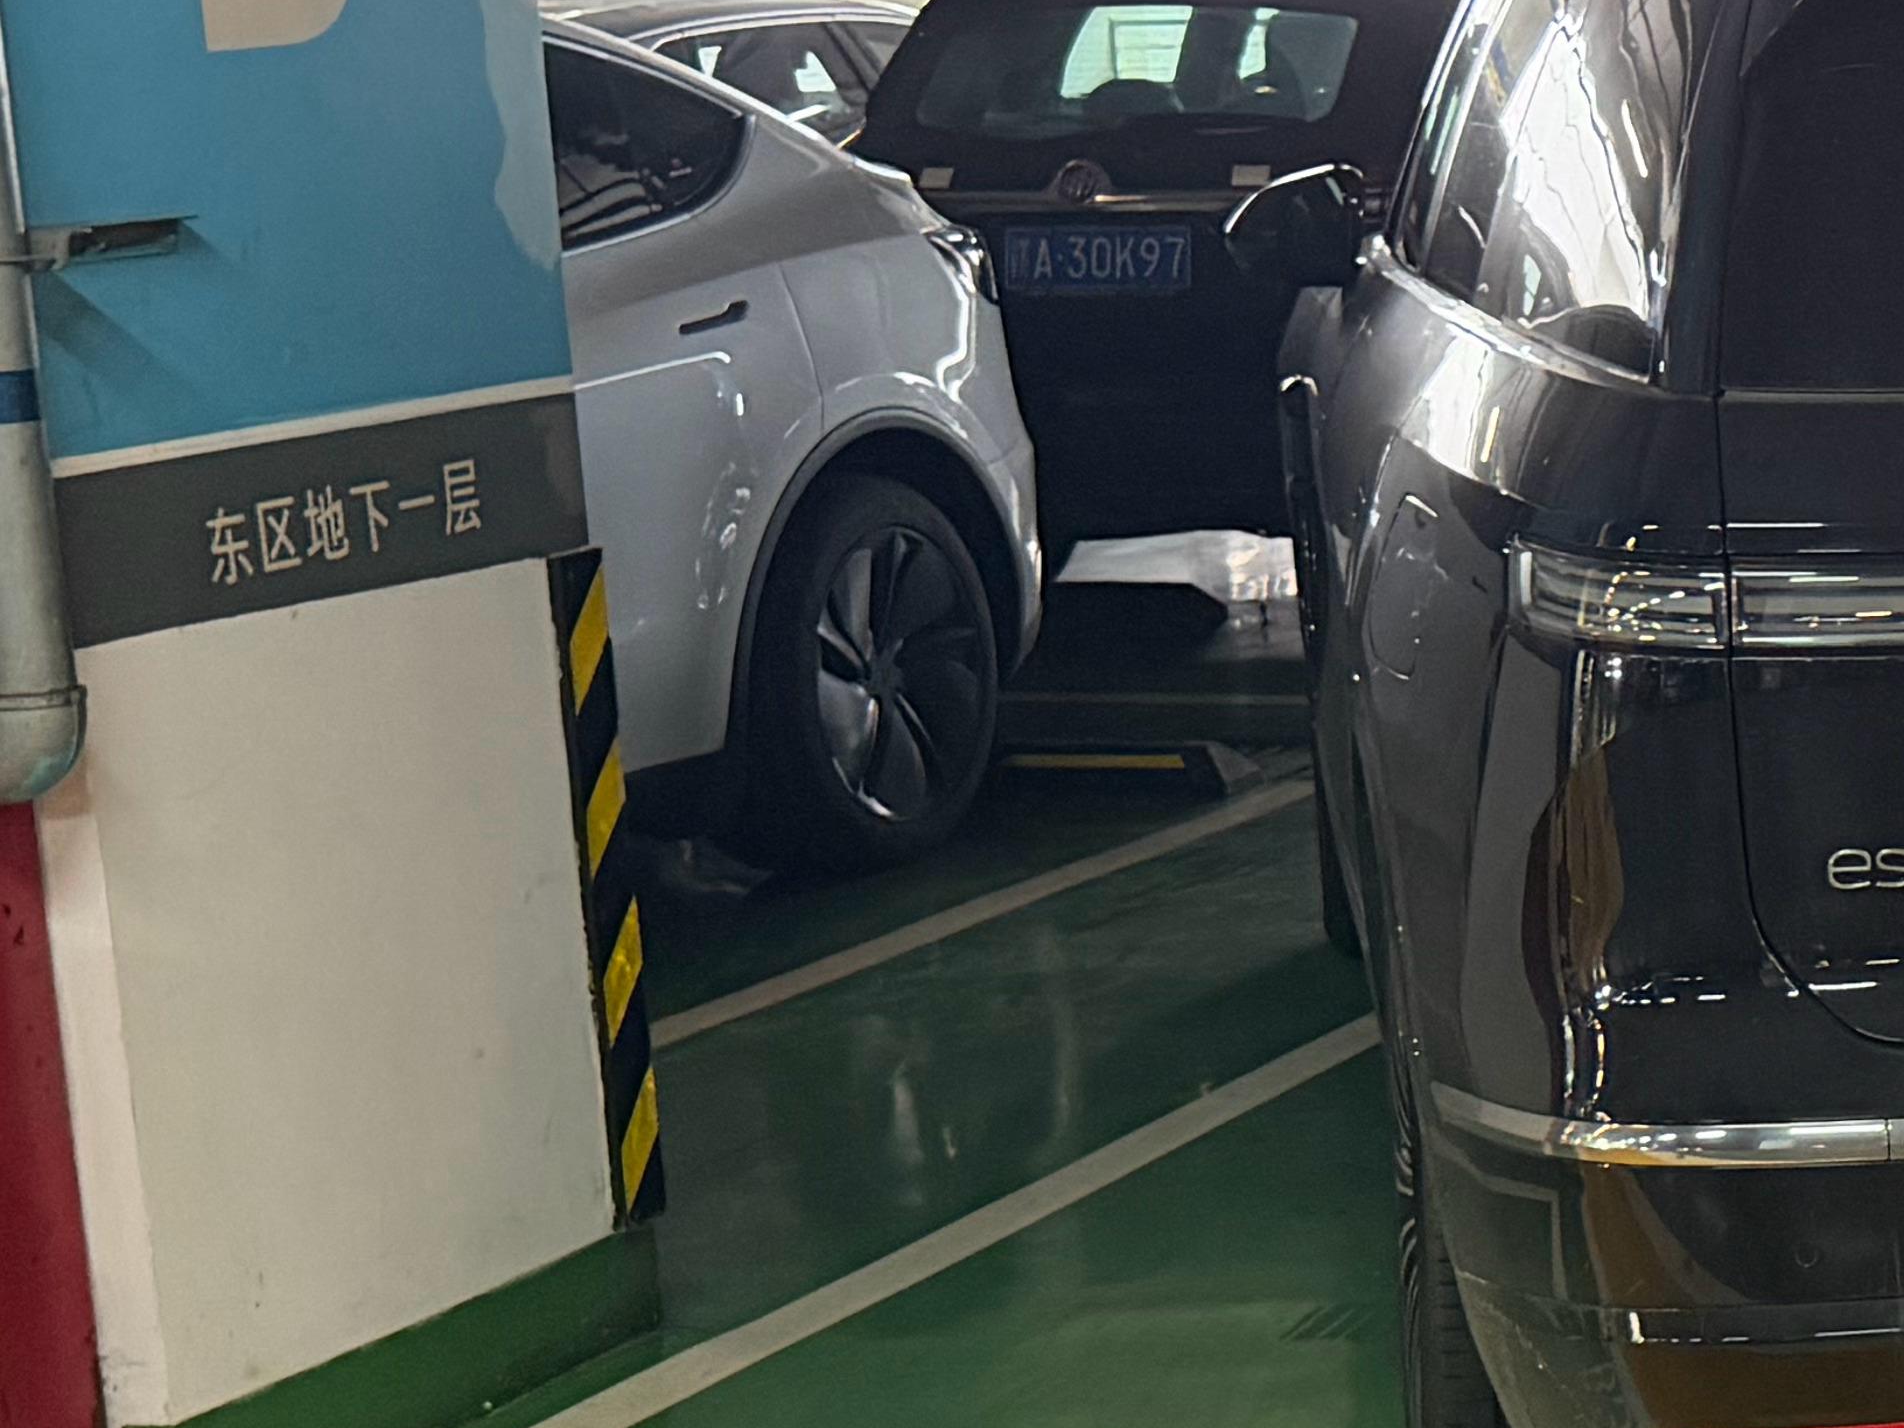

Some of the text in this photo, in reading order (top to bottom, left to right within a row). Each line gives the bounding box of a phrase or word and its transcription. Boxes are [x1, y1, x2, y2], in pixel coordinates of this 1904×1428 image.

[205, 458, 482, 586] 东区地下一层
